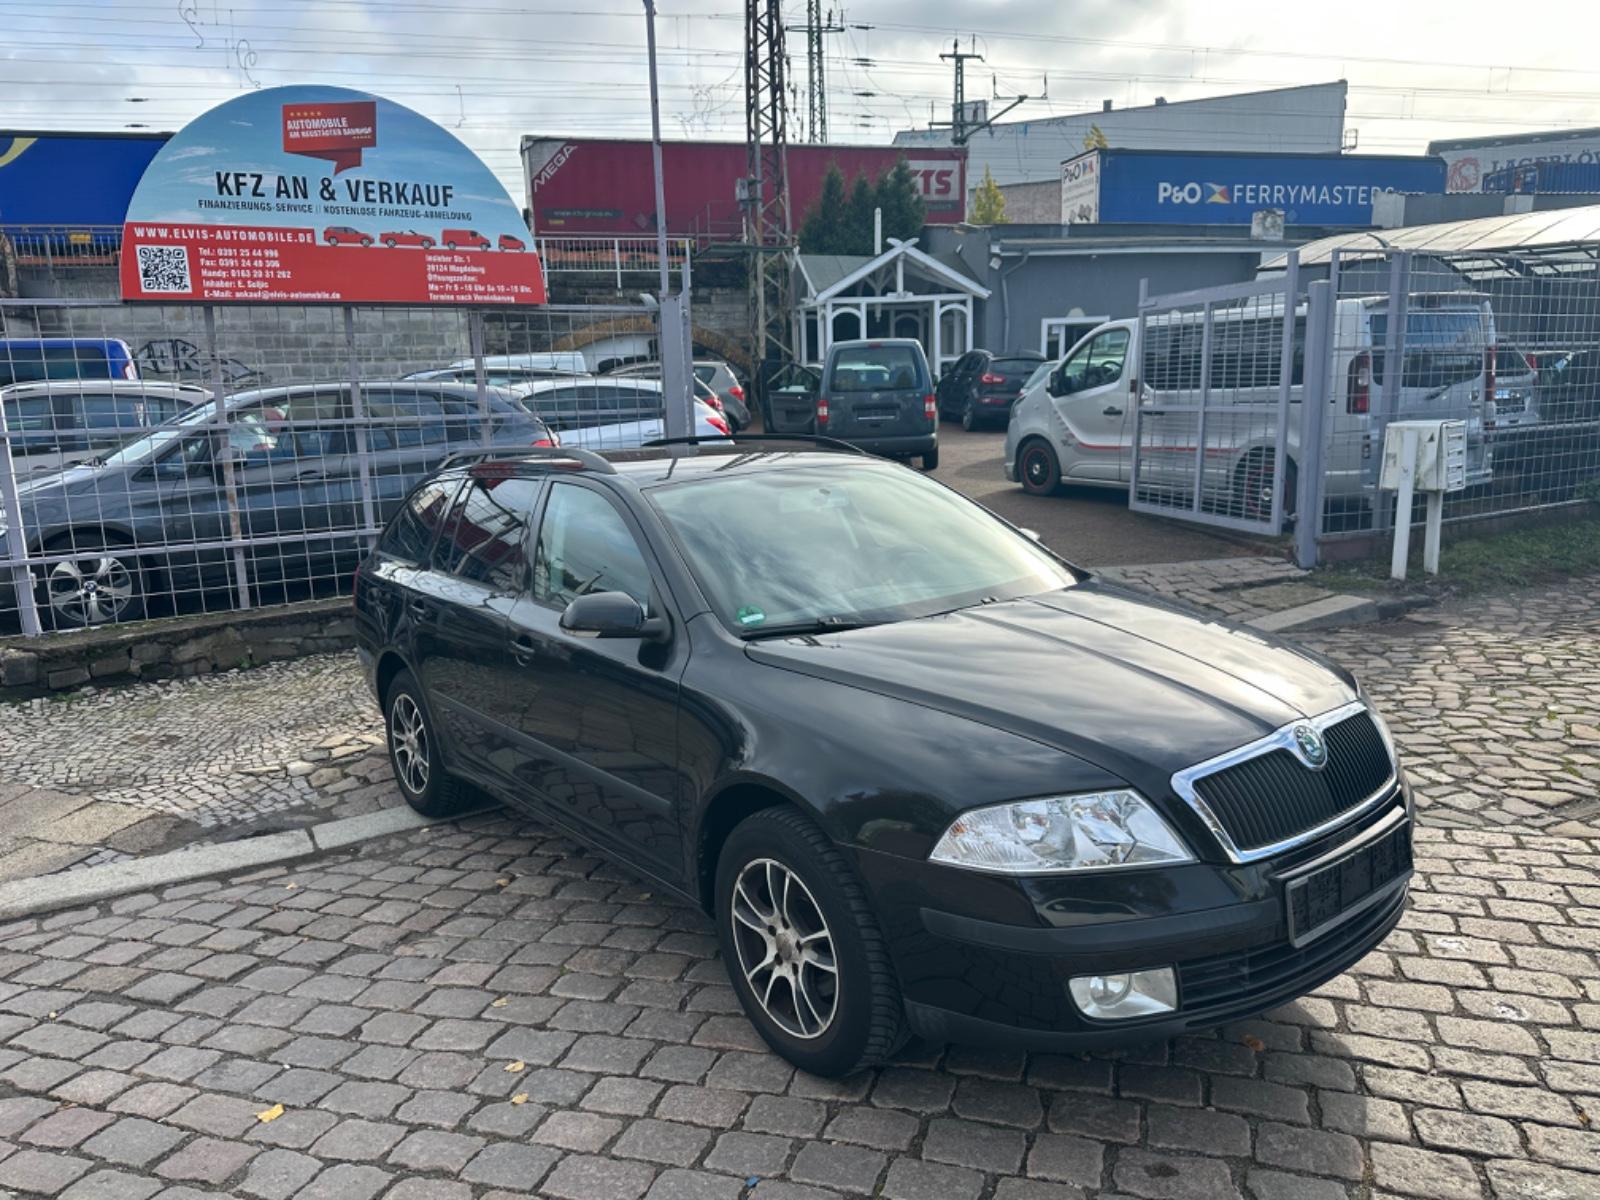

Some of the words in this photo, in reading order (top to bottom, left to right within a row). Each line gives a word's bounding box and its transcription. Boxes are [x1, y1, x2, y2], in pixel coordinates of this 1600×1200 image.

[286, 116, 349, 130] AUTOMOBILE
[534, 145, 579, 192] MEGA
[216, 171, 265, 197] KFZ
[275, 175, 309, 199] AN
[319, 177, 337, 201] &
[345, 179, 454, 207] VERKAUF
[1158, 182, 1200, 204] P&O
[198, 199, 313, 213] FINANZIERUNGS-SERVICE
[323, 205, 377, 216] KOSTENLOSE
[134, 227, 313, 243] WWW.ELVIS-AUTOMOBILE.DE
[201, 268, 230, 278] Handy:
